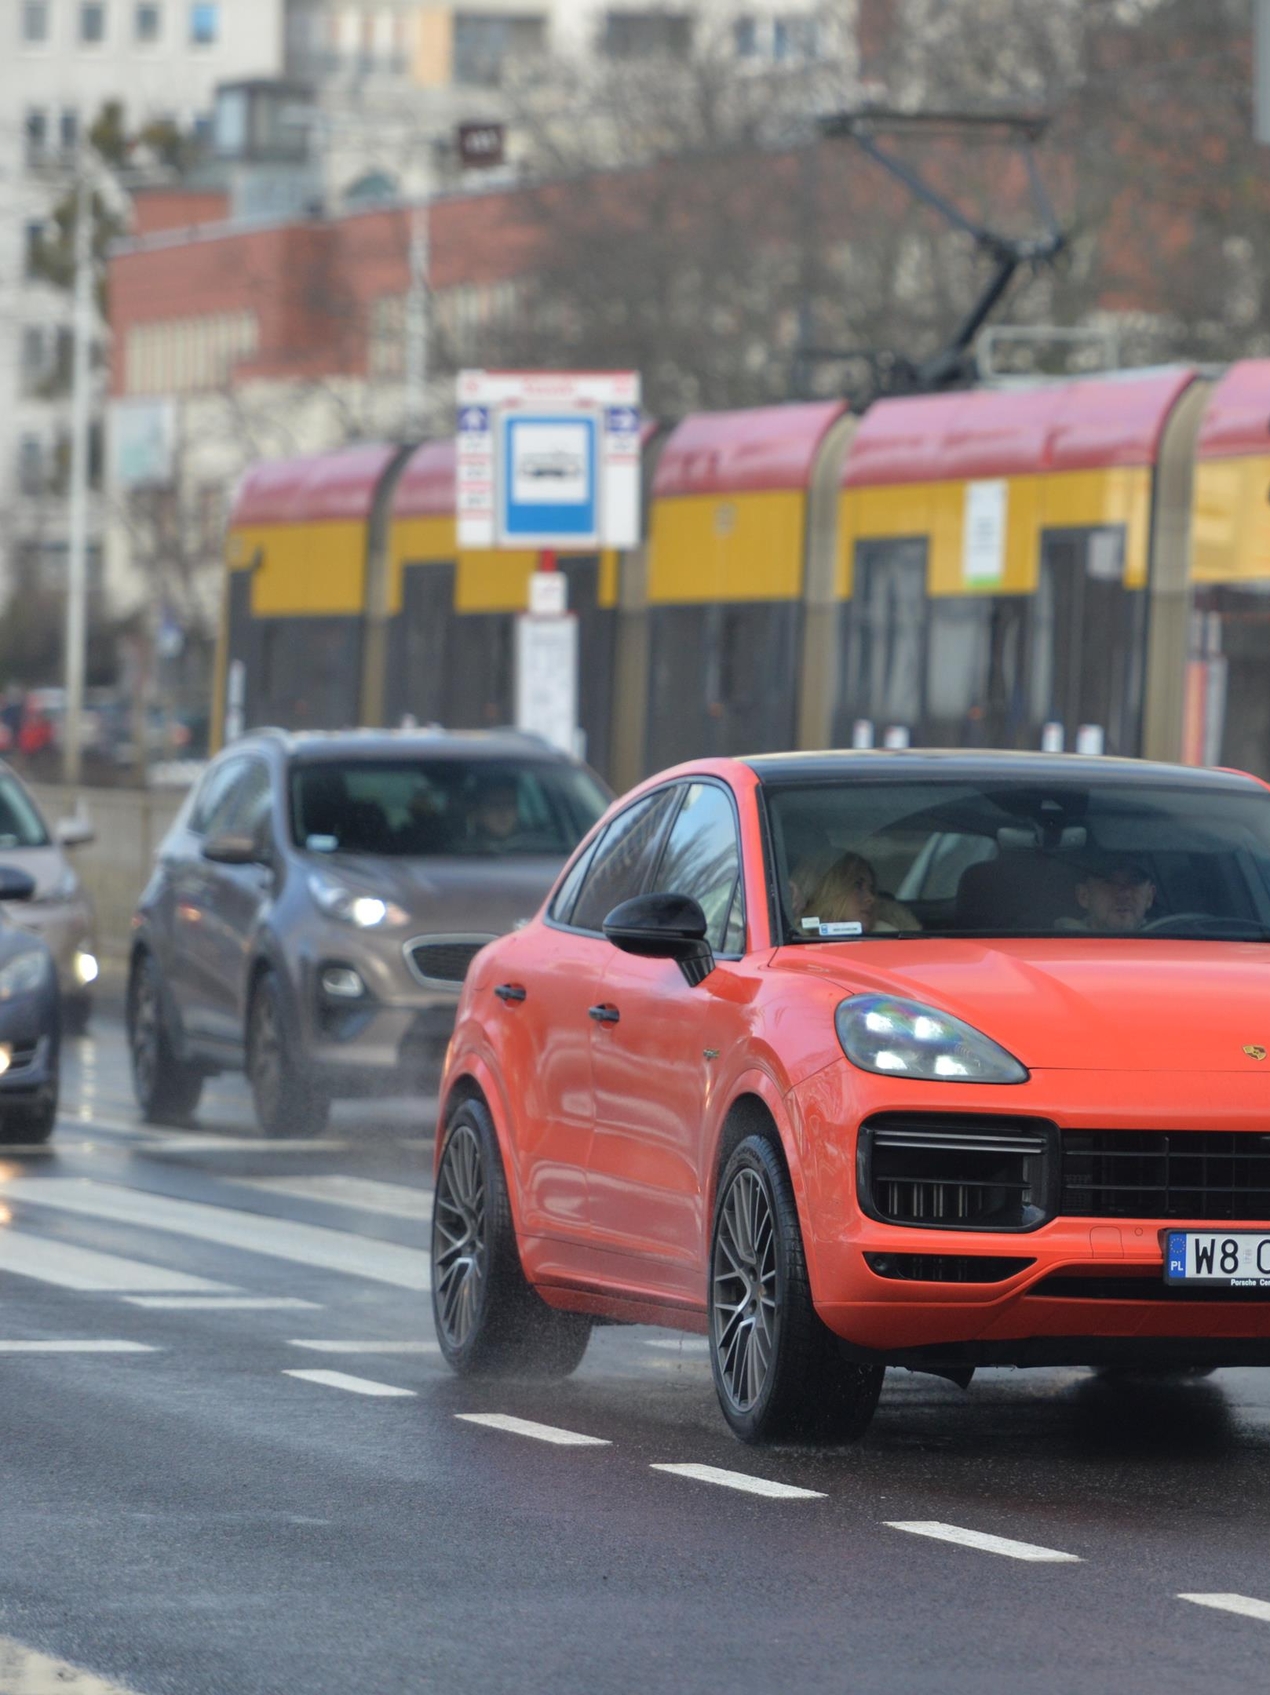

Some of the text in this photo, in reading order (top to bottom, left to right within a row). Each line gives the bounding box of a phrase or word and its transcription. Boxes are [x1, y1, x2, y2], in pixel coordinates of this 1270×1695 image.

[1195, 1238, 1239, 1275] W8
[1170, 1260, 1184, 1271] PL
[1230, 1278, 1257, 1287] Porsche
